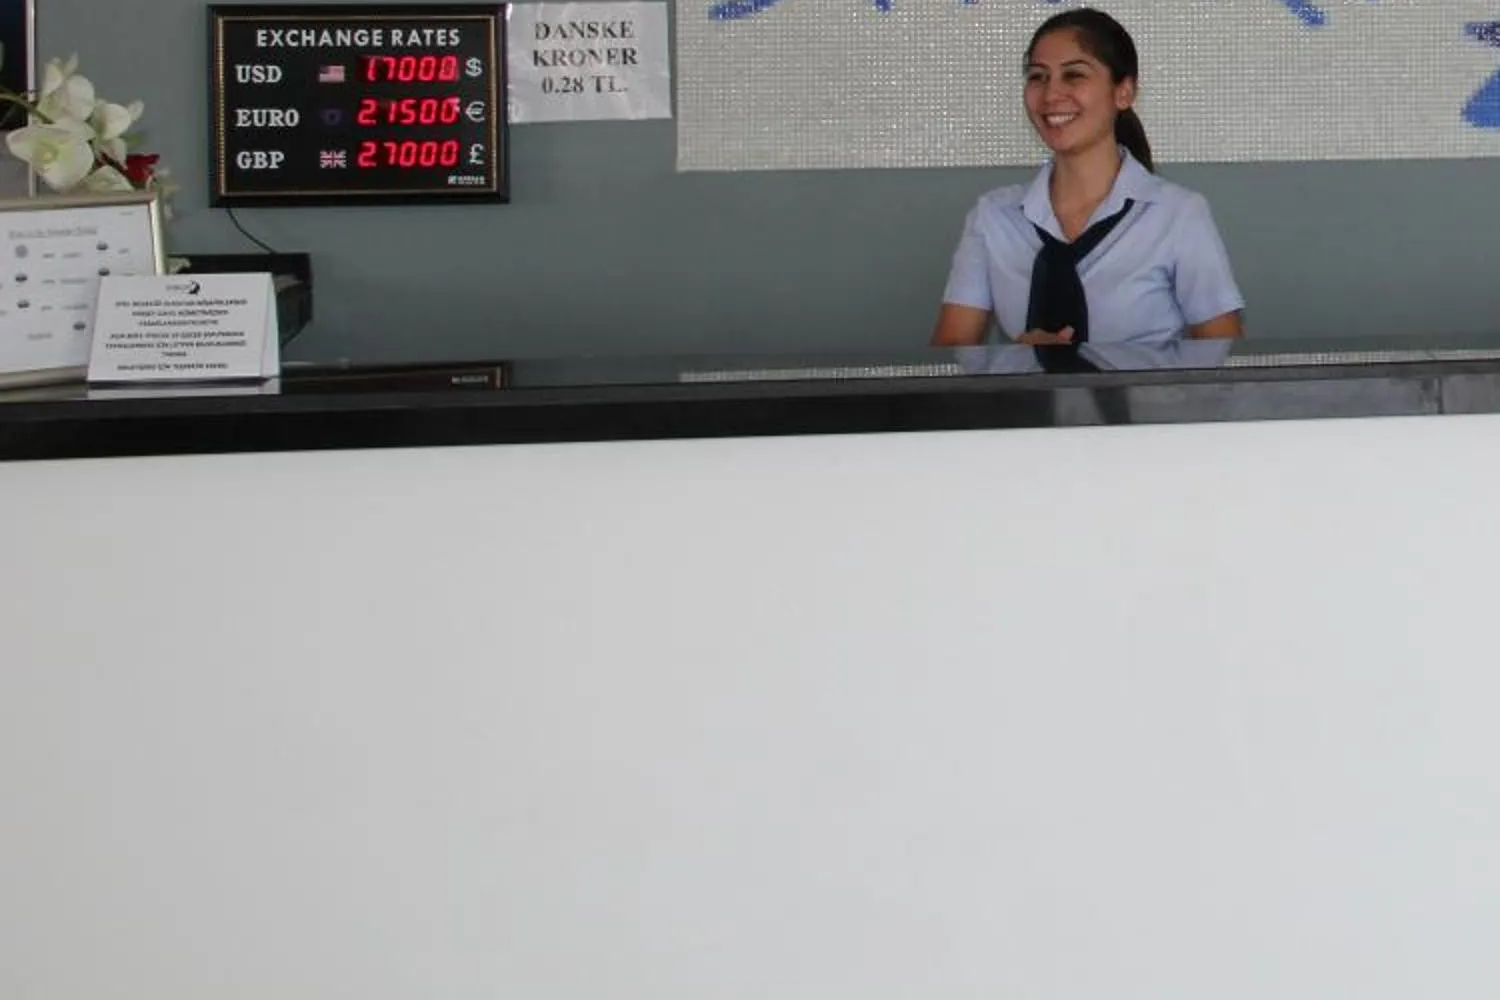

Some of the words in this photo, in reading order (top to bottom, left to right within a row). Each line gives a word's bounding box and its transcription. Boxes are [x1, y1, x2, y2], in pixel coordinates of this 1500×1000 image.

[256, 29, 384, 48] EXCHANGE
[391, 28, 461, 46] RATES
[535, 20, 634, 40] DANSKE
[533, 47, 639, 67] KRONER
[235, 64, 283, 84] USD
[465, 57, 483, 78] $
[541, 76, 585, 94] 0.28
[236, 108, 300, 127] EURO
[465, 100, 486, 122] €
[236, 150, 285, 169] GBP
[357, 140, 459, 167] 27000
[469, 143, 485, 165] £
